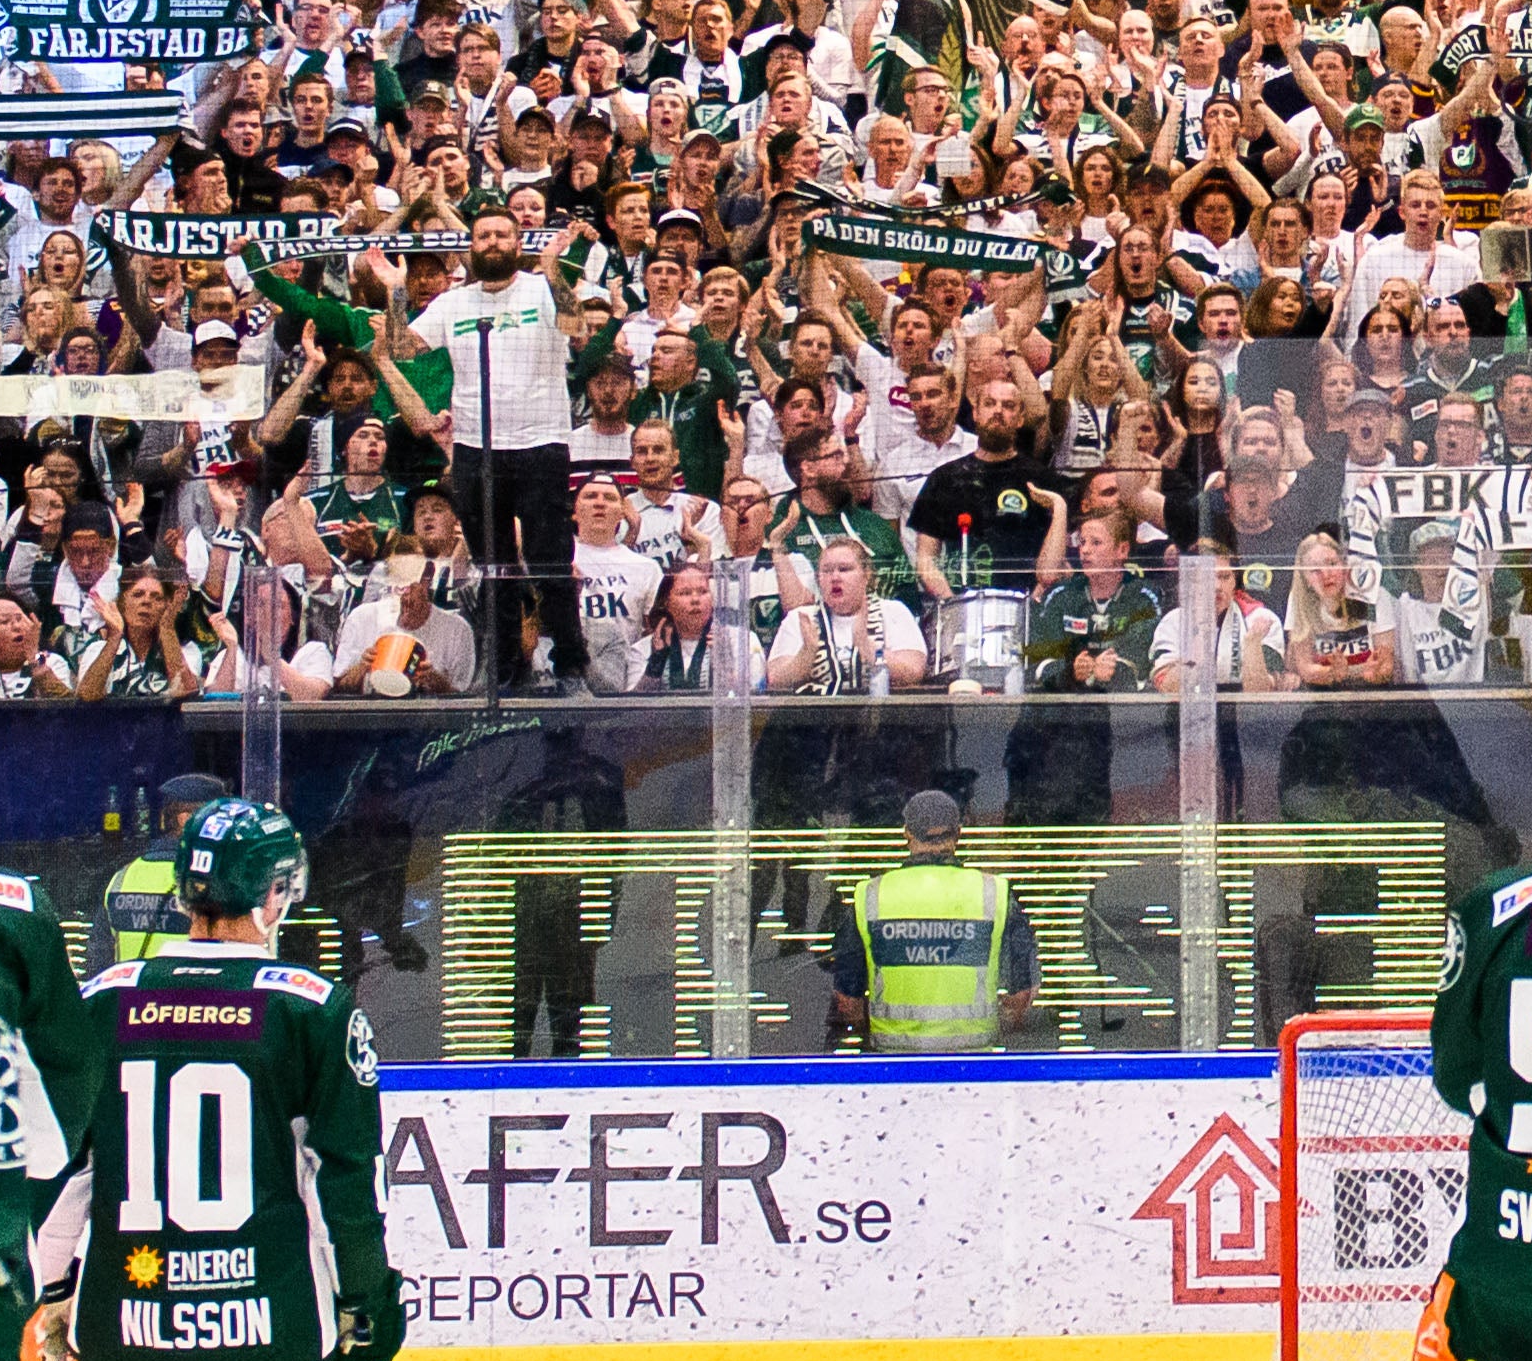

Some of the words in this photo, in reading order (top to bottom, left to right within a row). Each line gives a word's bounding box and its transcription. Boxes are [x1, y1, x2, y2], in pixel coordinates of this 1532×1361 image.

[30, 26, 206, 59] FÄRJESTAD
[1444, 35, 1482, 72] STORT
[812, 215, 838, 240] PÅ
[842, 223, 880, 248] DEN
[884, 225, 948, 254] SKÖLD
[952, 234, 980, 256] DU
[1385, 471, 1491, 516] FBK
[1416, 639, 1475, 675] FBK
[191, 848, 213, 873] 10
[882, 921, 977, 942] ORDNINGS
[904, 945, 951, 964] VAKT
[129, 1001, 252, 1028] LÖFBERGS
[118, 1060, 255, 1233] 10
[167, 1248, 255, 1284] ENERGI
[121, 1297, 273, 1350] NILSSON
